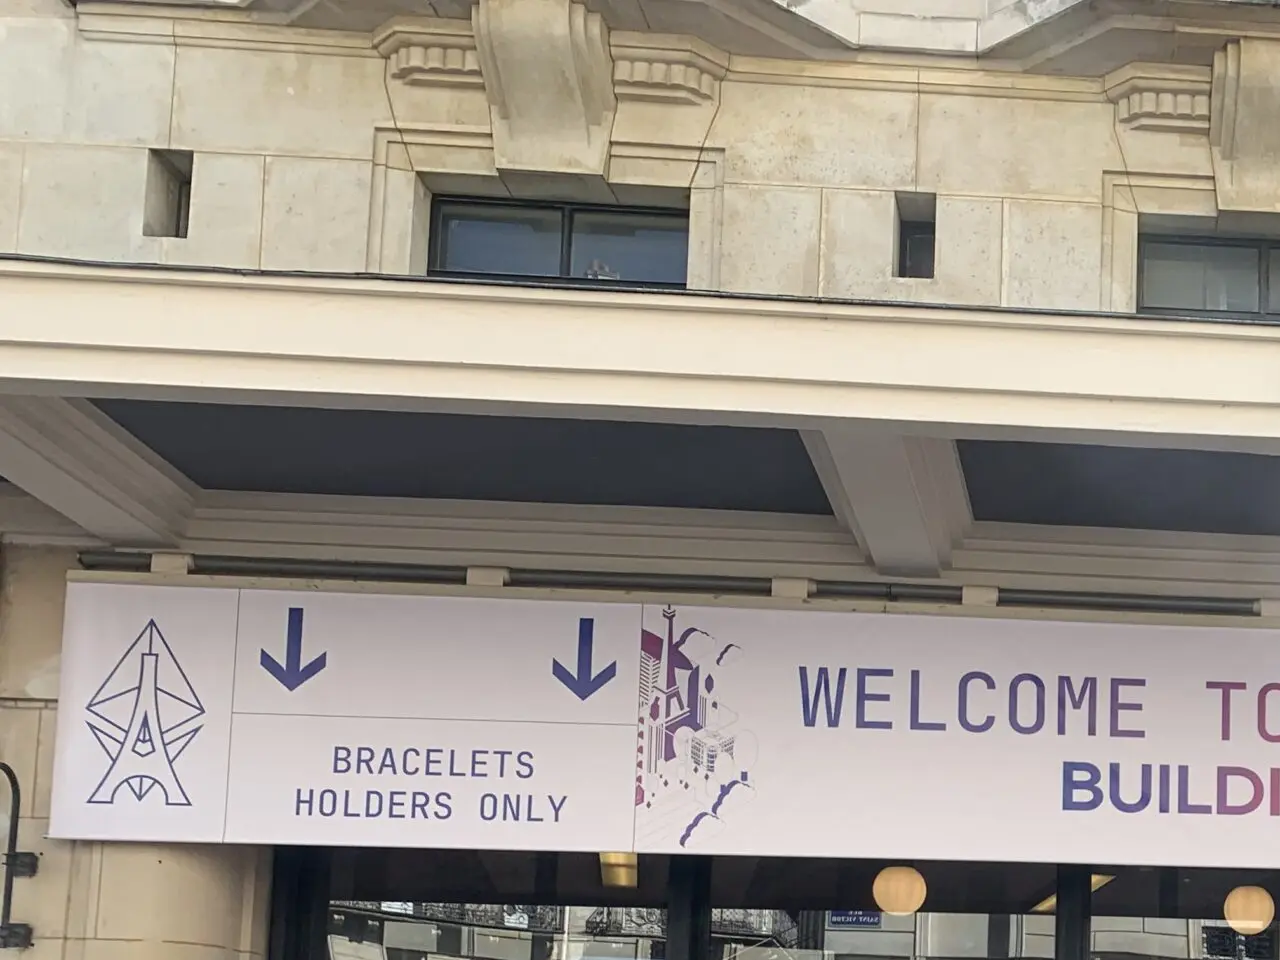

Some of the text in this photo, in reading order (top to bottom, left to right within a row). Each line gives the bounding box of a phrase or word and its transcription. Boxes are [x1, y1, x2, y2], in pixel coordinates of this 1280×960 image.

[799, 665, 1147, 738] WELCOME
[332, 746, 534, 779] BRACELETS
[295, 788, 567, 822] HOLDERS ONLY
